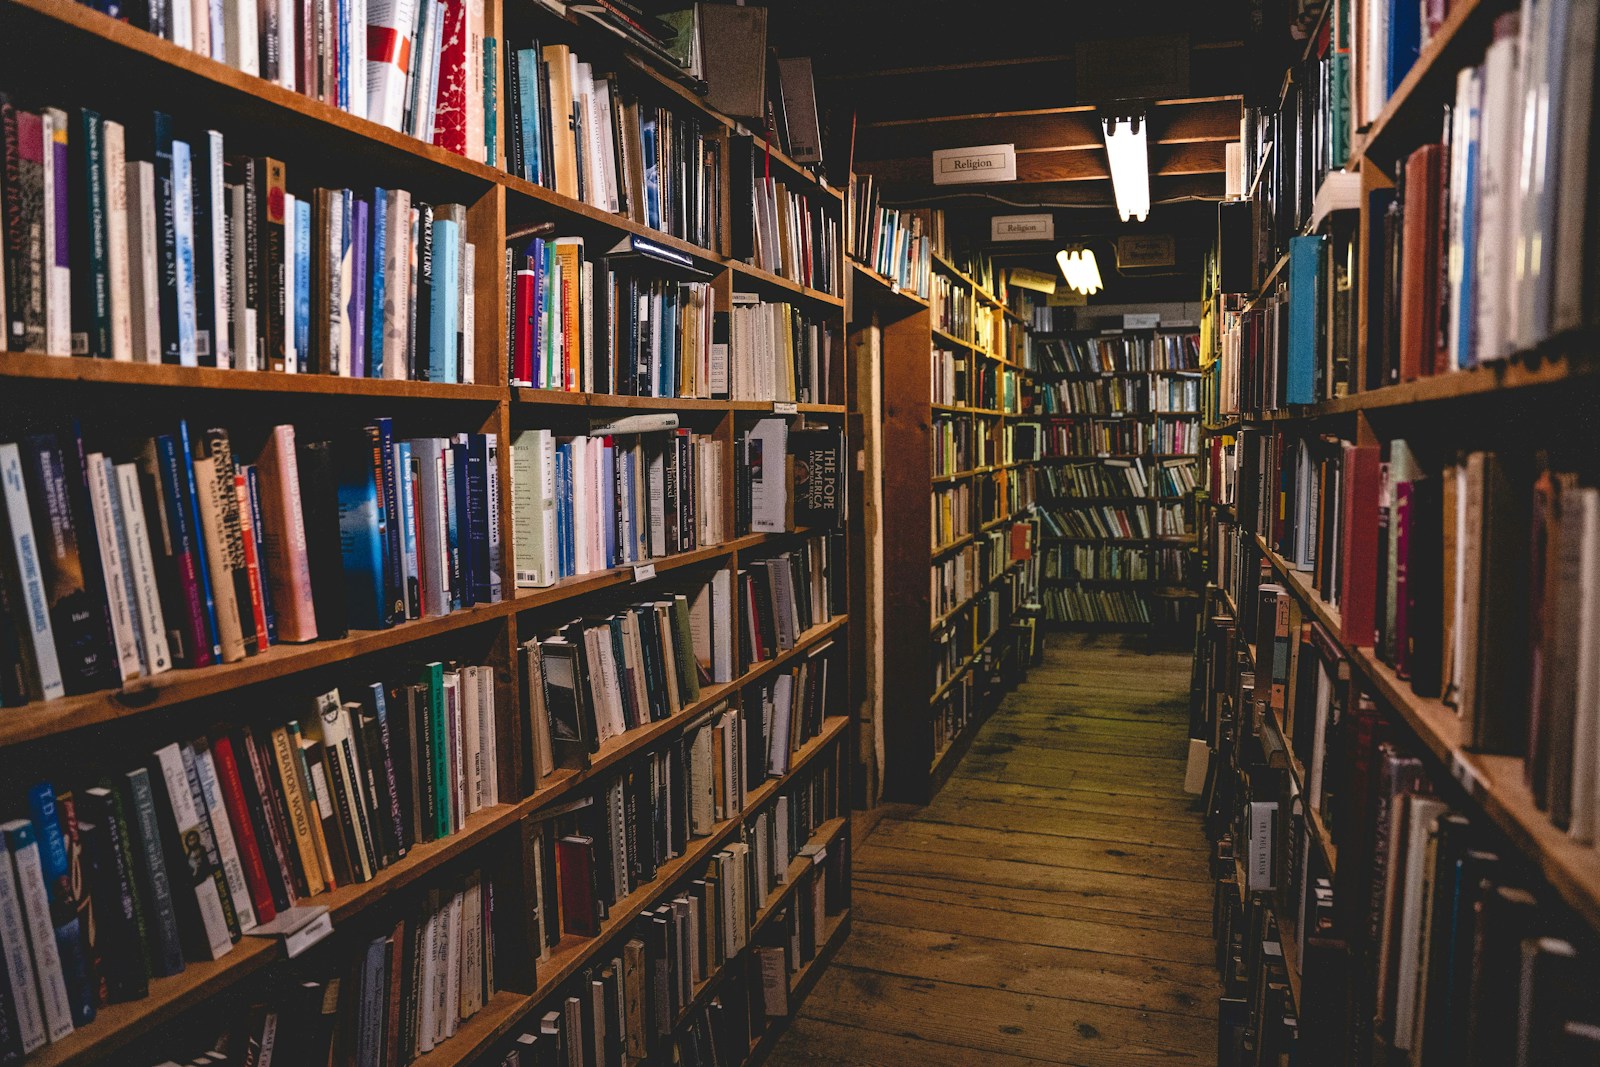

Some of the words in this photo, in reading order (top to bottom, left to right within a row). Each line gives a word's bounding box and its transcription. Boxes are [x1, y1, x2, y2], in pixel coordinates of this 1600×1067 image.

[954, 157, 992, 171] Religion
[163, 200, 175, 247] SHAME
[1007, 223, 1037, 233] Religion
[402, 458, 412, 481] Bishop
[815, 450, 823, 462] IN
[824, 448, 836, 474] THE
[386, 458, 396, 520] REVELATION
[403, 482, 414, 506] Speaks
[666, 466, 674, 498] Trained
[814, 464, 823, 509] AMERICA
[824, 478, 835, 509] POPE
[407, 518, 416, 536] Mind
[20, 534, 36, 579] VANISHING
[275, 733, 298, 794] OPERATION
[290, 796, 308, 836] WORLD
[428, 784, 433, 792] IN
[139, 802, 154, 840] Home
[45, 822, 64, 866] JAKES
[148, 842, 160, 864] with
[152, 866, 167, 900] God
